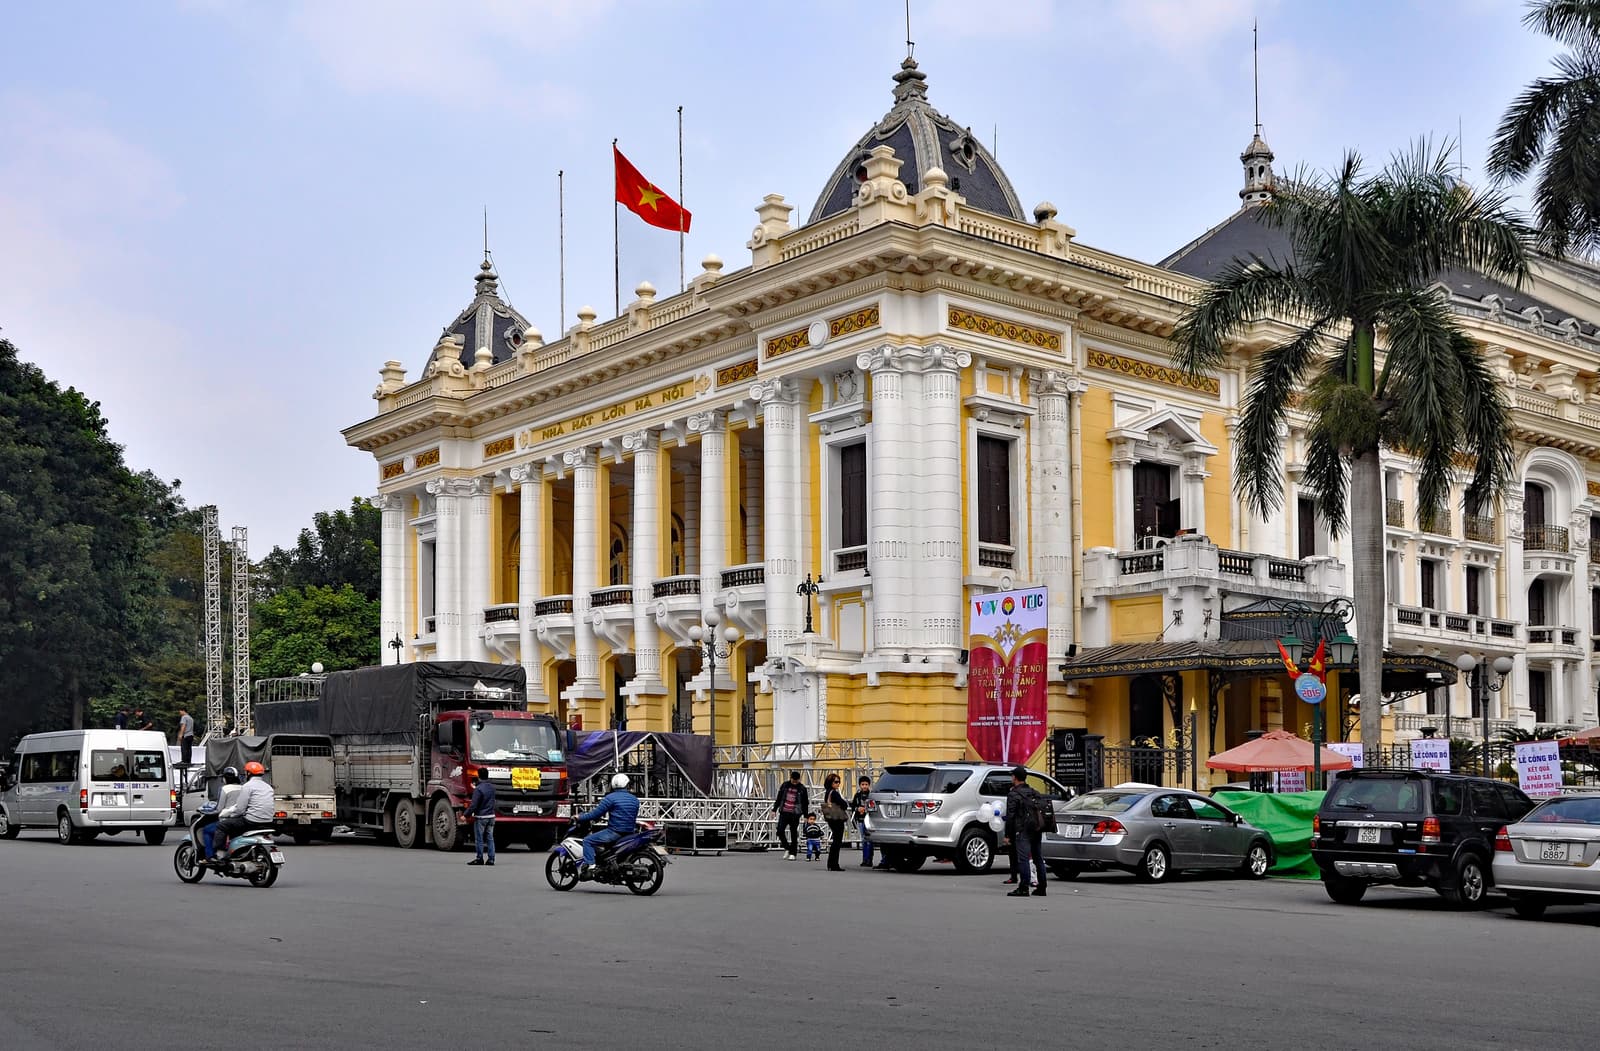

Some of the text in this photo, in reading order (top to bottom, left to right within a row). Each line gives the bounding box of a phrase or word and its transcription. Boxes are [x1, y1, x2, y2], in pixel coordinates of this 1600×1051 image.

[542, 423, 565, 440] NHÀ
[572, 414, 594, 431] HÁT
[602, 405, 626, 421] LỚN
[635, 396, 652, 411] HÀ
[975, 600, 998, 616] VOV
[1302, 688, 1321, 697] 2015
[1543, 851, 1564, 859] 6887
